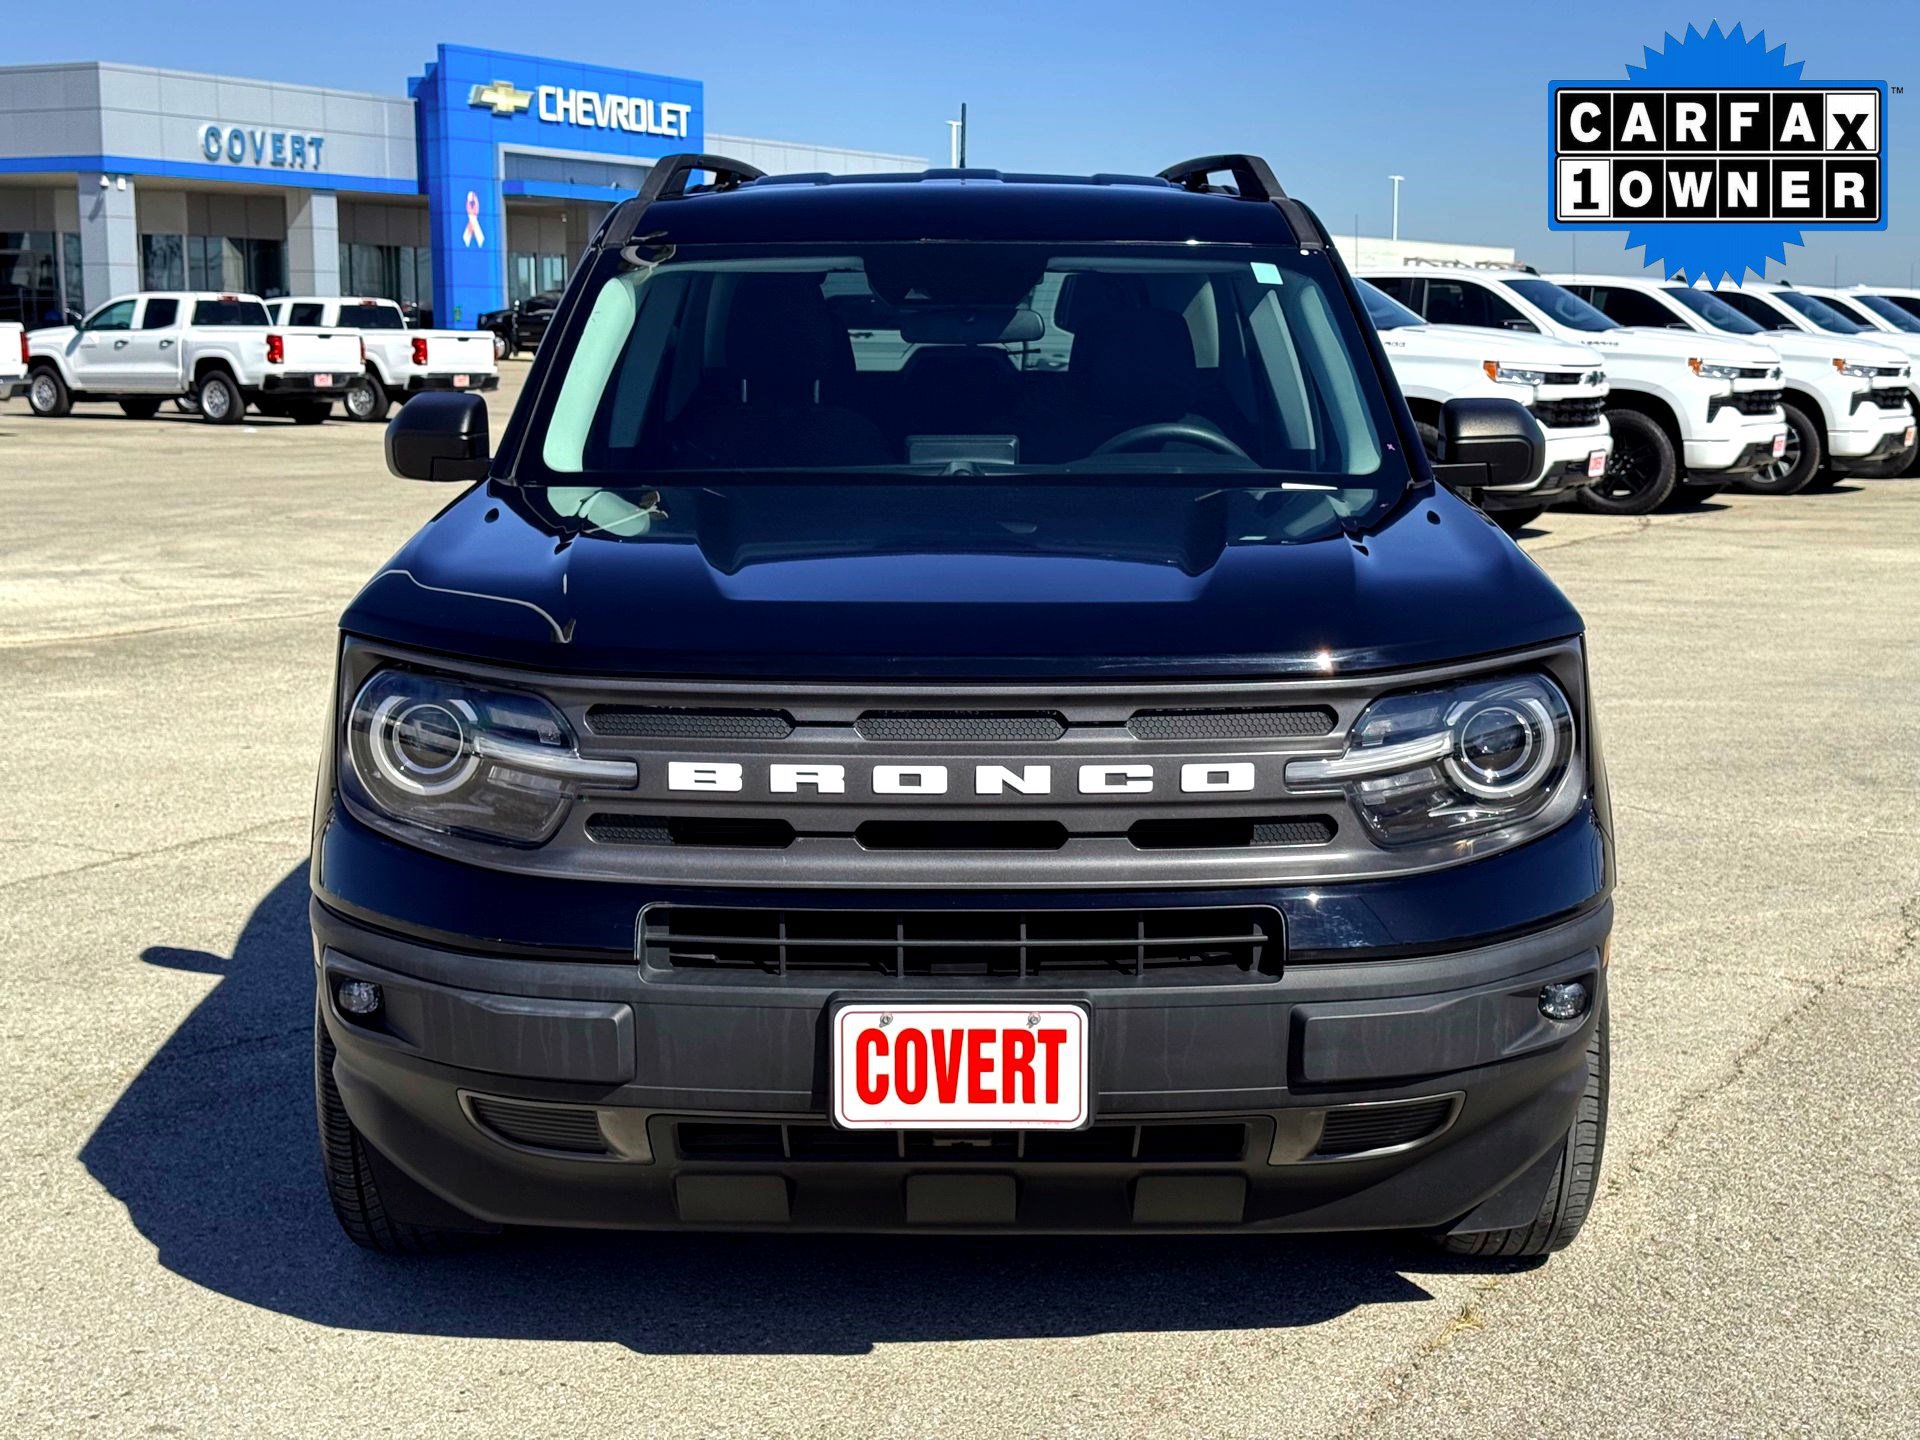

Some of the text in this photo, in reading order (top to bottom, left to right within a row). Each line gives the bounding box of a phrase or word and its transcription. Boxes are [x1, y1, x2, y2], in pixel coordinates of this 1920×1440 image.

[538, 85, 692, 138] CHEVROLET
[203, 126, 325, 169] COVERT
[668, 761, 1255, 795] BRONCO
[856, 1028, 1067, 1105] COVERT
